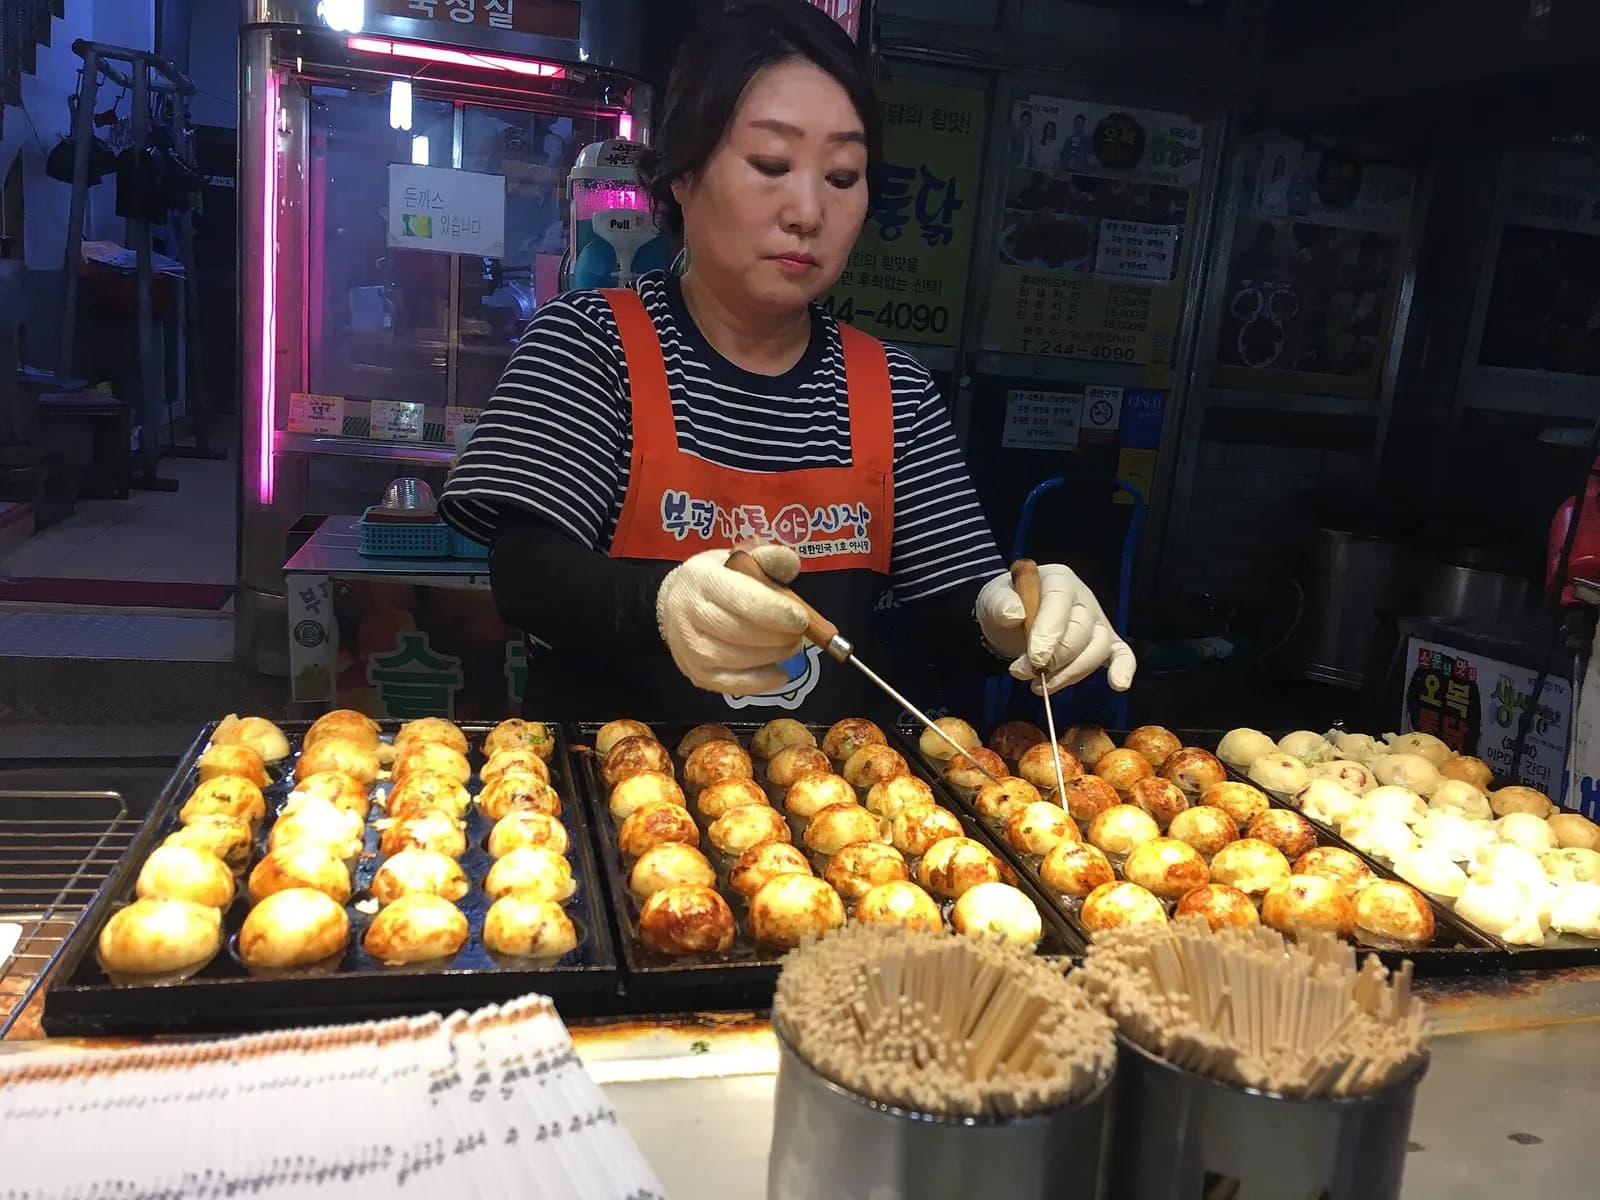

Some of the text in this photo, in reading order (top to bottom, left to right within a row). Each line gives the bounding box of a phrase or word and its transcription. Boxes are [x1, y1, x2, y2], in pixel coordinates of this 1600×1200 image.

[879, 102, 923, 129] 닭의
[404, 187, 445, 210] 돈까스
[440, 215, 482, 237] 있습니다
[610, 219, 630, 230] Pull
[858, 271, 909, 292] 후회없는
[913, 279, 943, 295] 선택!
[1020, 338, 1137, 361] T.244-4090
[799, 540, 870, 555] 대한민국 1호 야시장
[1420, 650, 1477, 683] 소문난 맛집
[1420, 674, 1472, 720] 오복
